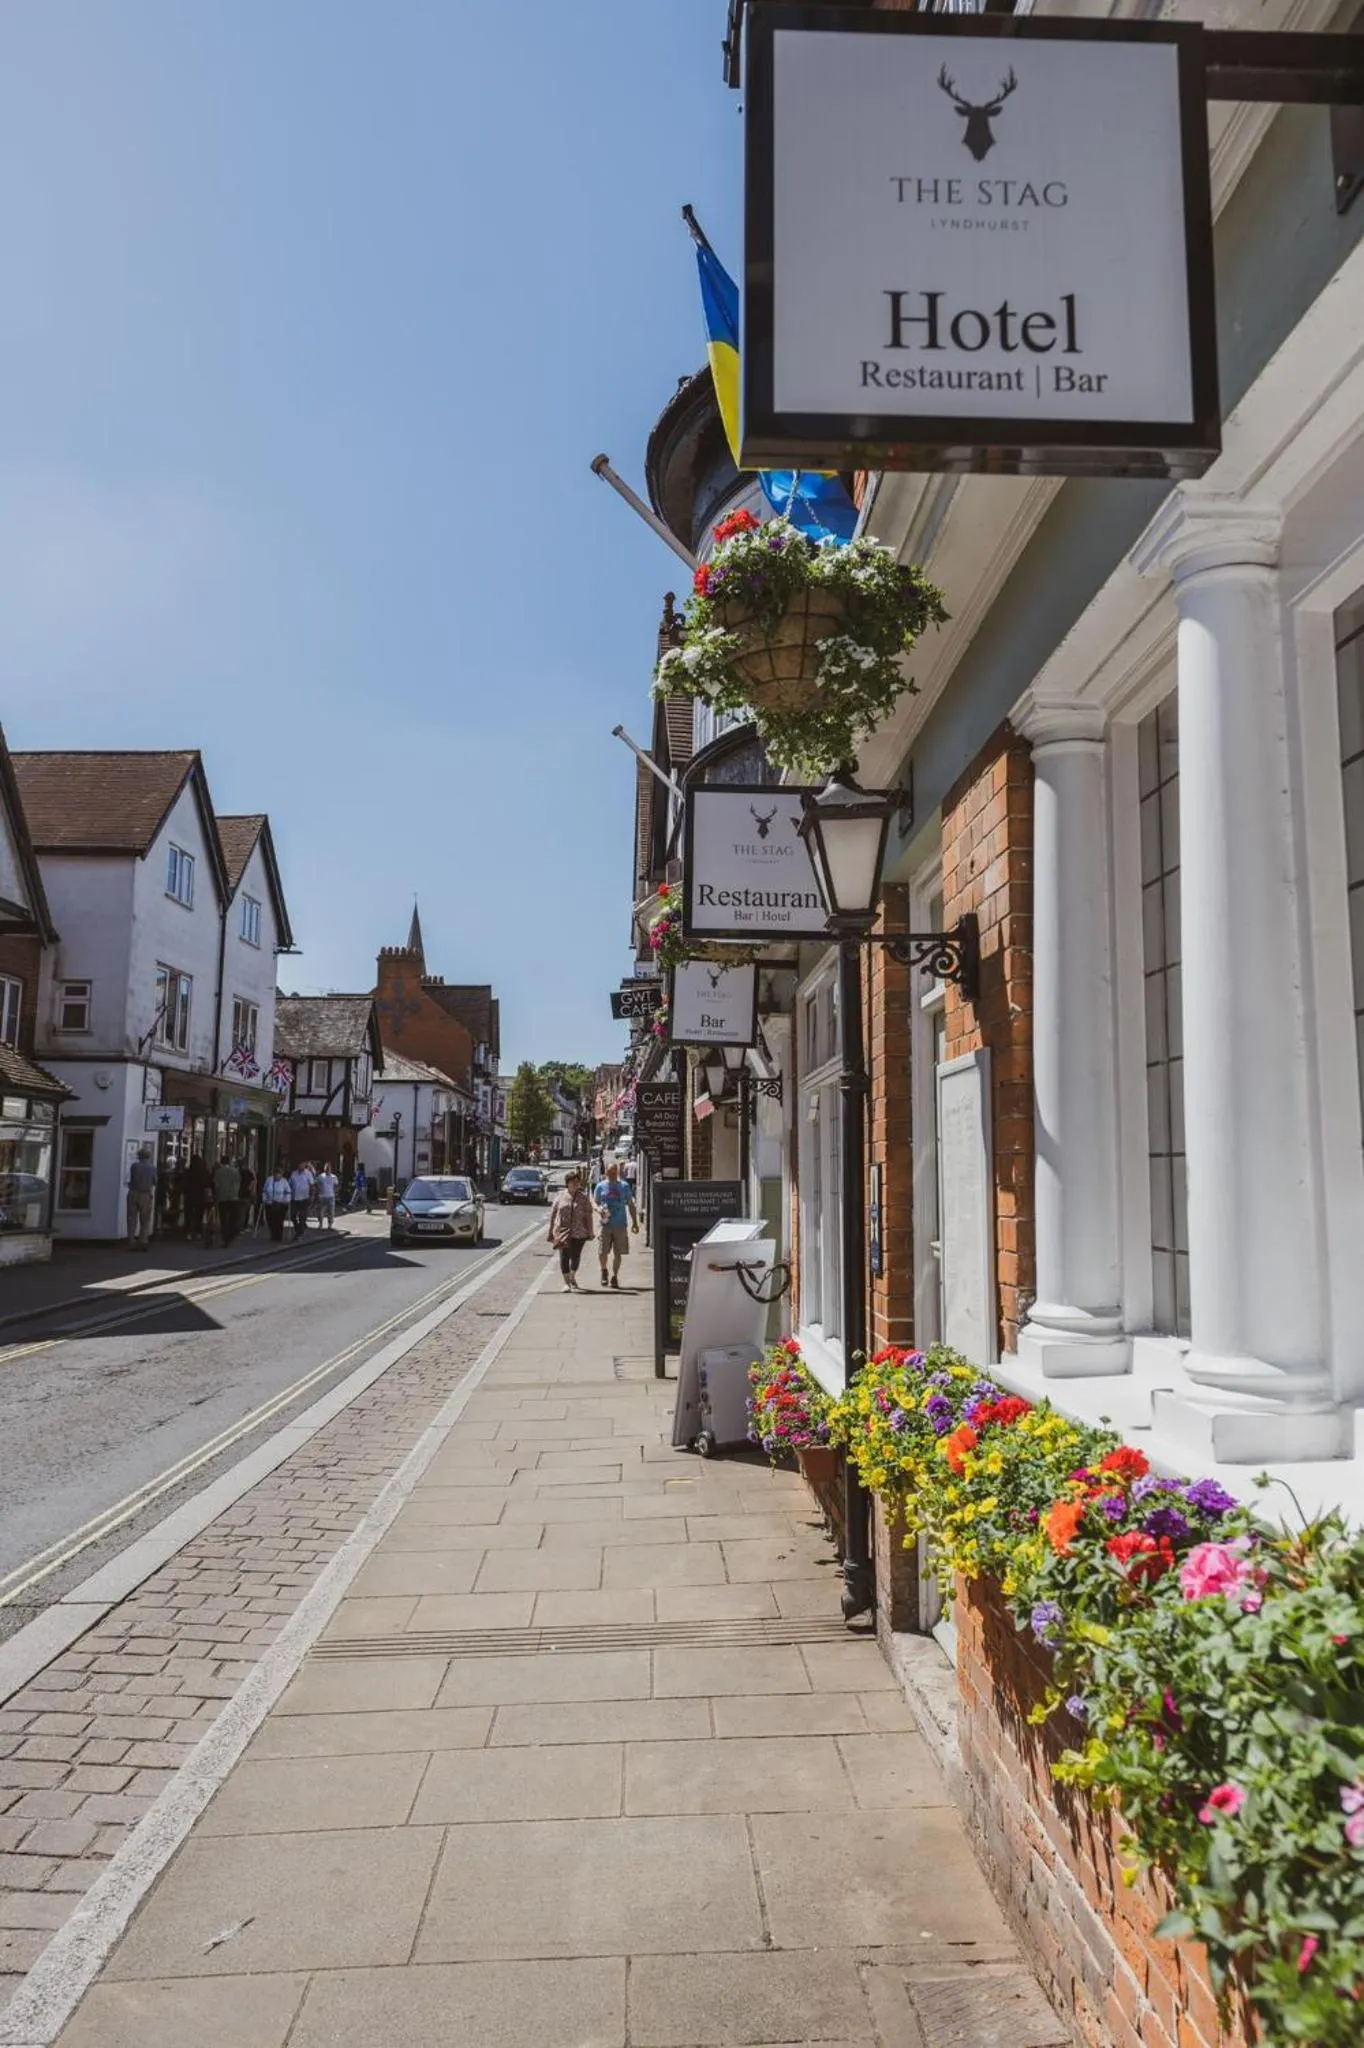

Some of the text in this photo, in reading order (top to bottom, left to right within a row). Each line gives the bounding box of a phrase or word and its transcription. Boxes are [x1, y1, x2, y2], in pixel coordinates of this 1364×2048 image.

[890, 176, 1070, 210] THE STAG
[930, 217, 1031, 233] LYNDHURST
[882, 289, 1085, 355] Hotel
[859, 360, 1109, 394] Restaurant Bar
[733, 844, 795, 857] THE STAG
[734, 910, 791, 922] Bar Hotel
[619, 1002, 656, 1017] CAFE
[700, 1014, 727, 1028] Bar
[642, 1092, 680, 1105] CAFE
